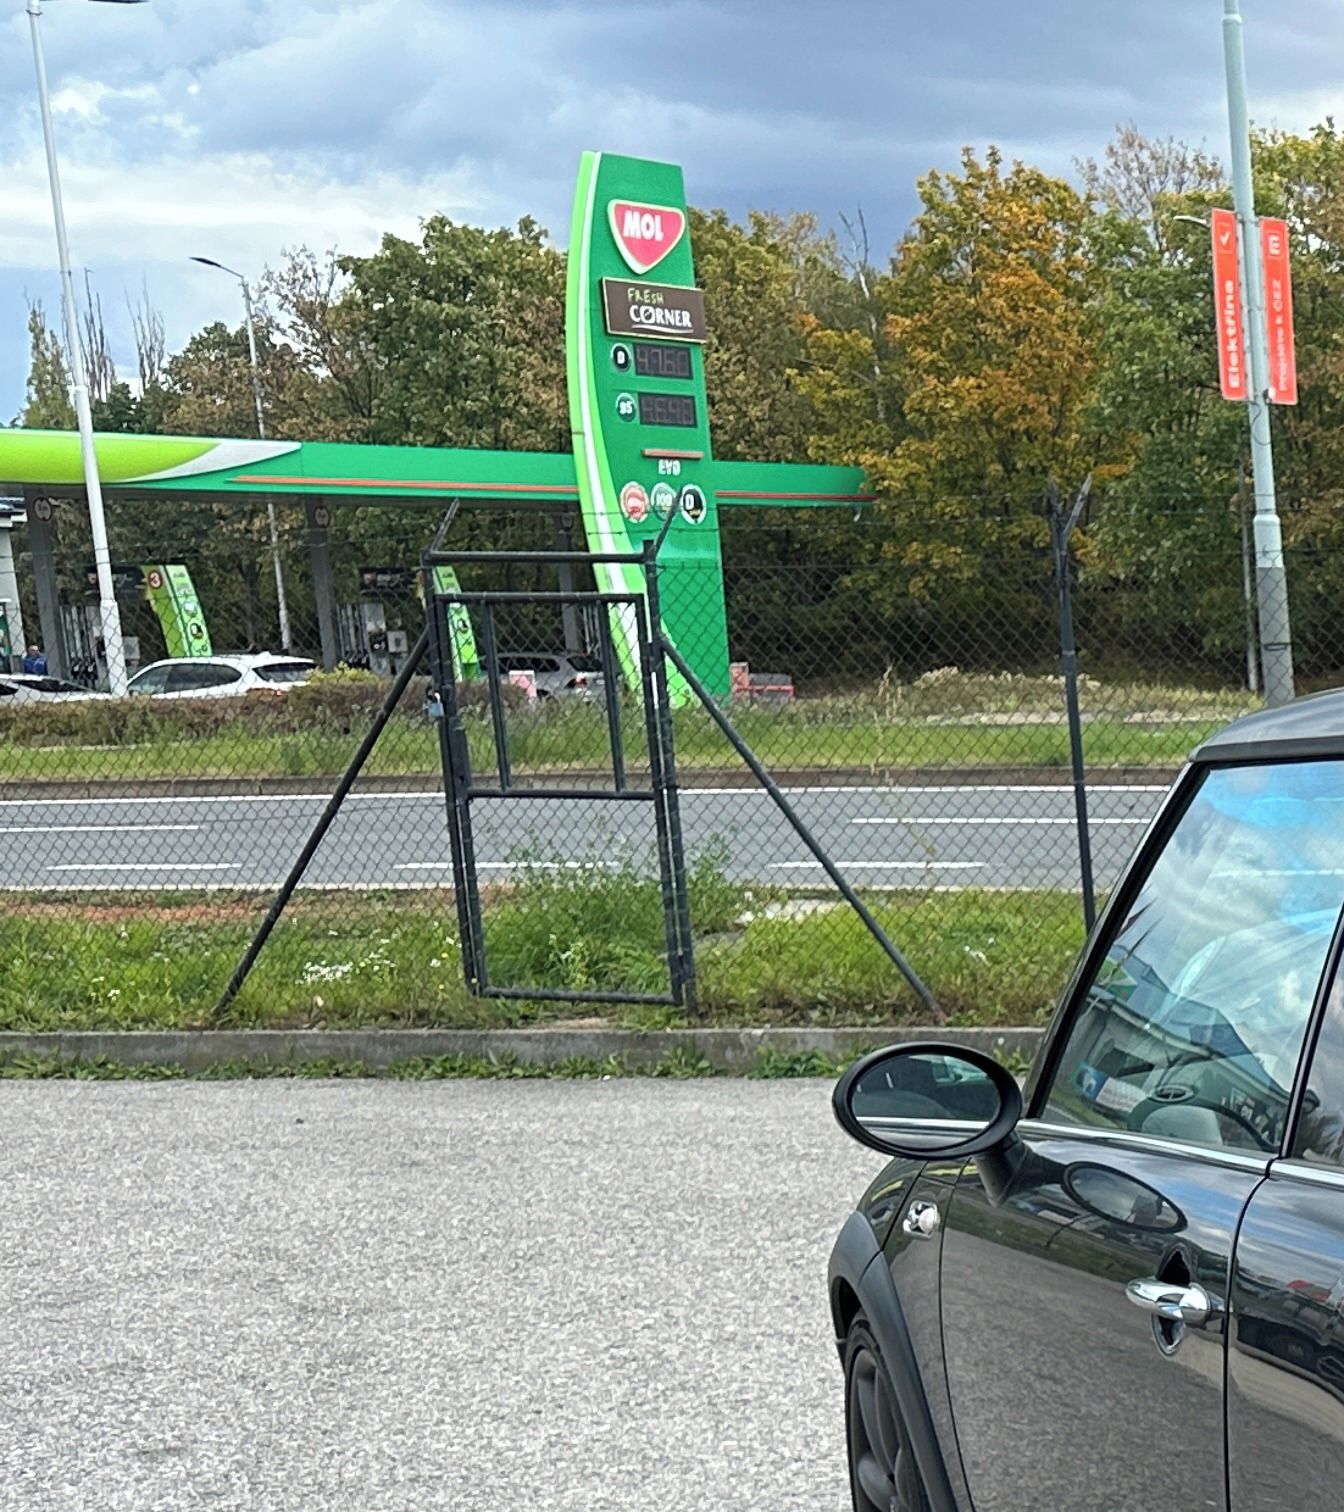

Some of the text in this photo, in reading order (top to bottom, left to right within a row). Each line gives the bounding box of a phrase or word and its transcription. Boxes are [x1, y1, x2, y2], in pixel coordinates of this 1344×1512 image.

[623, 210, 664, 242] MOL
[627, 287, 664, 305] FRESH
[629, 305, 692, 328] CORNER
